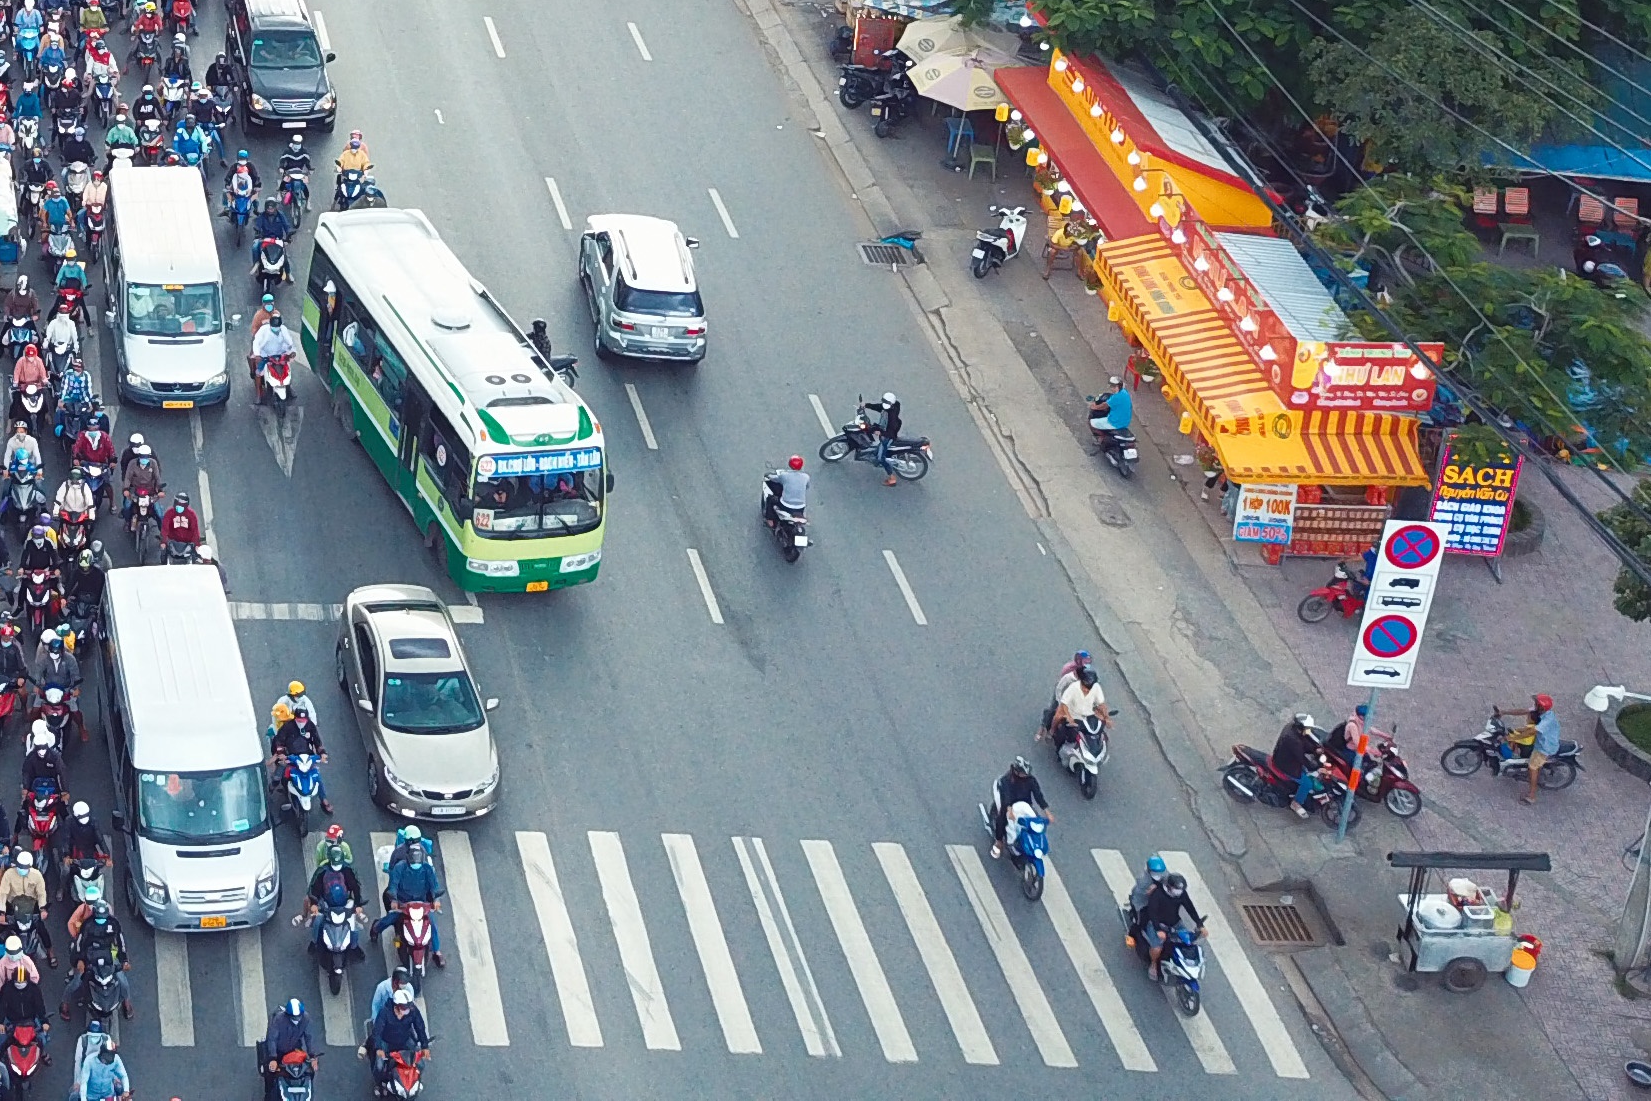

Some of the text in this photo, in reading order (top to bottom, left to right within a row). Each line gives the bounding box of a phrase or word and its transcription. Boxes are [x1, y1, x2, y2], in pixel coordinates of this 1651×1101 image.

[1369, 365, 1406, 386] LAN
[1242, 496, 1248, 511] 1
[1266, 498, 1291, 516] 100K
[475, 516, 490, 528] 622
[1261, 526, 1288, 541] 50%
